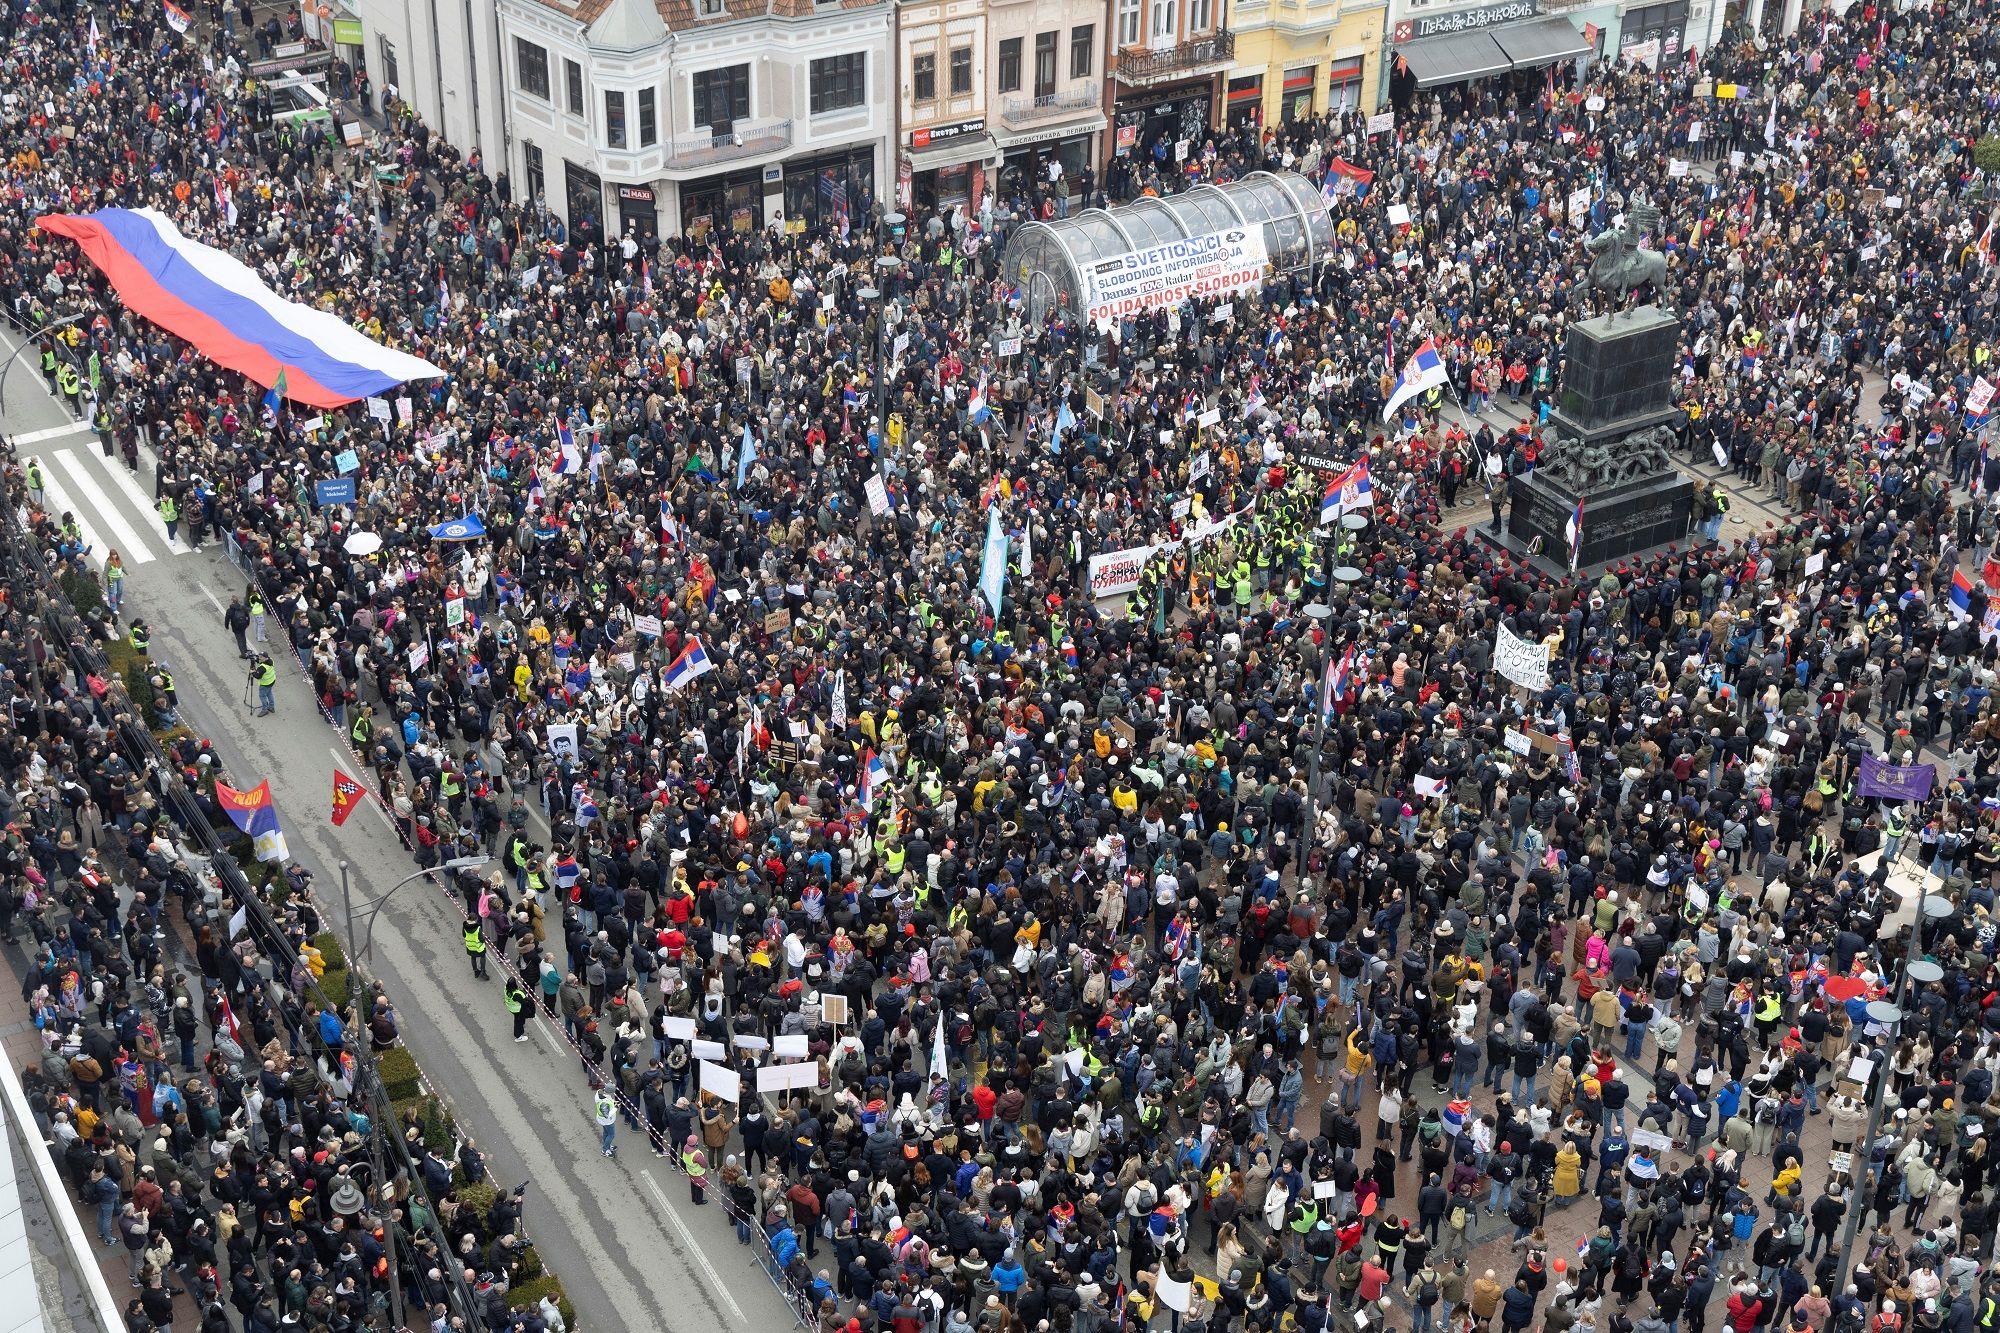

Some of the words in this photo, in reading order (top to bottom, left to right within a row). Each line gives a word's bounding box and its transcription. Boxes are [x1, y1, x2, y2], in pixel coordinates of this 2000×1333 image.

[1010, 133, 1061, 145] ПОСЛАСТИЧАРА
[630, 190, 650, 199] MAXI
[1098, 266, 1163, 289] SLOBODNOG
[1165, 272, 1194, 286] Radar
[1090, 285, 1192, 320] SOLIDARNOST
[1197, 269, 1260, 295] SLOBODA
[1101, 286, 1138, 301] Danas
[1099, 565, 1109, 574] НЕ
